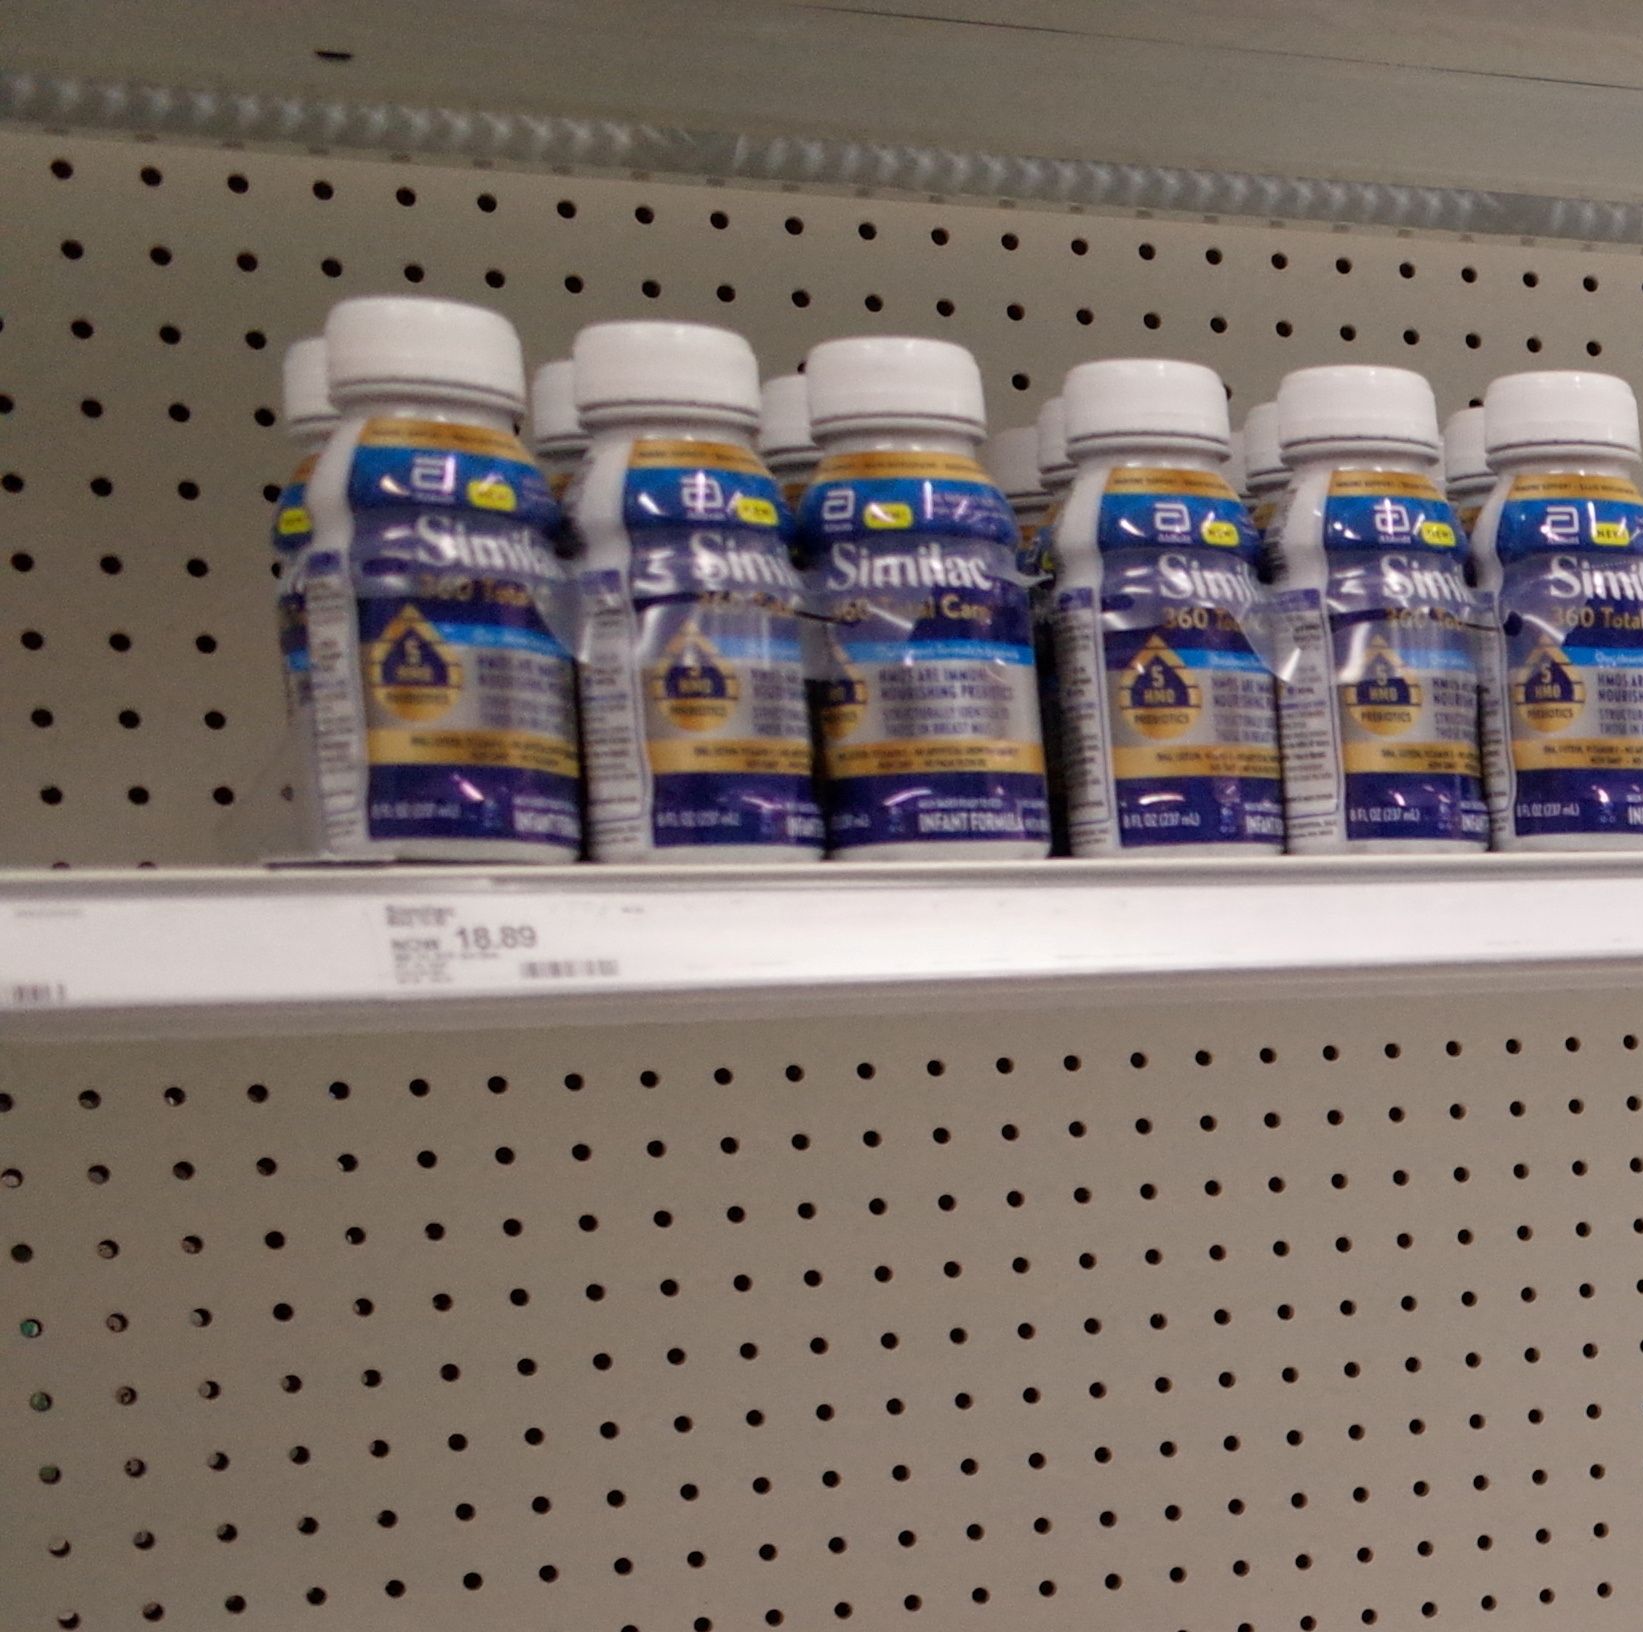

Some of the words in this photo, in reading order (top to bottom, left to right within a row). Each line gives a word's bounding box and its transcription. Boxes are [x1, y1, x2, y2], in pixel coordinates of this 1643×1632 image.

[826, 541, 993, 591] Similac
[1158, 552, 1257, 605] Simil
[1554, 606, 1595, 628] 360
[919, 812, 969, 832] INFANT
[456, 925, 537, 950] 18.89
